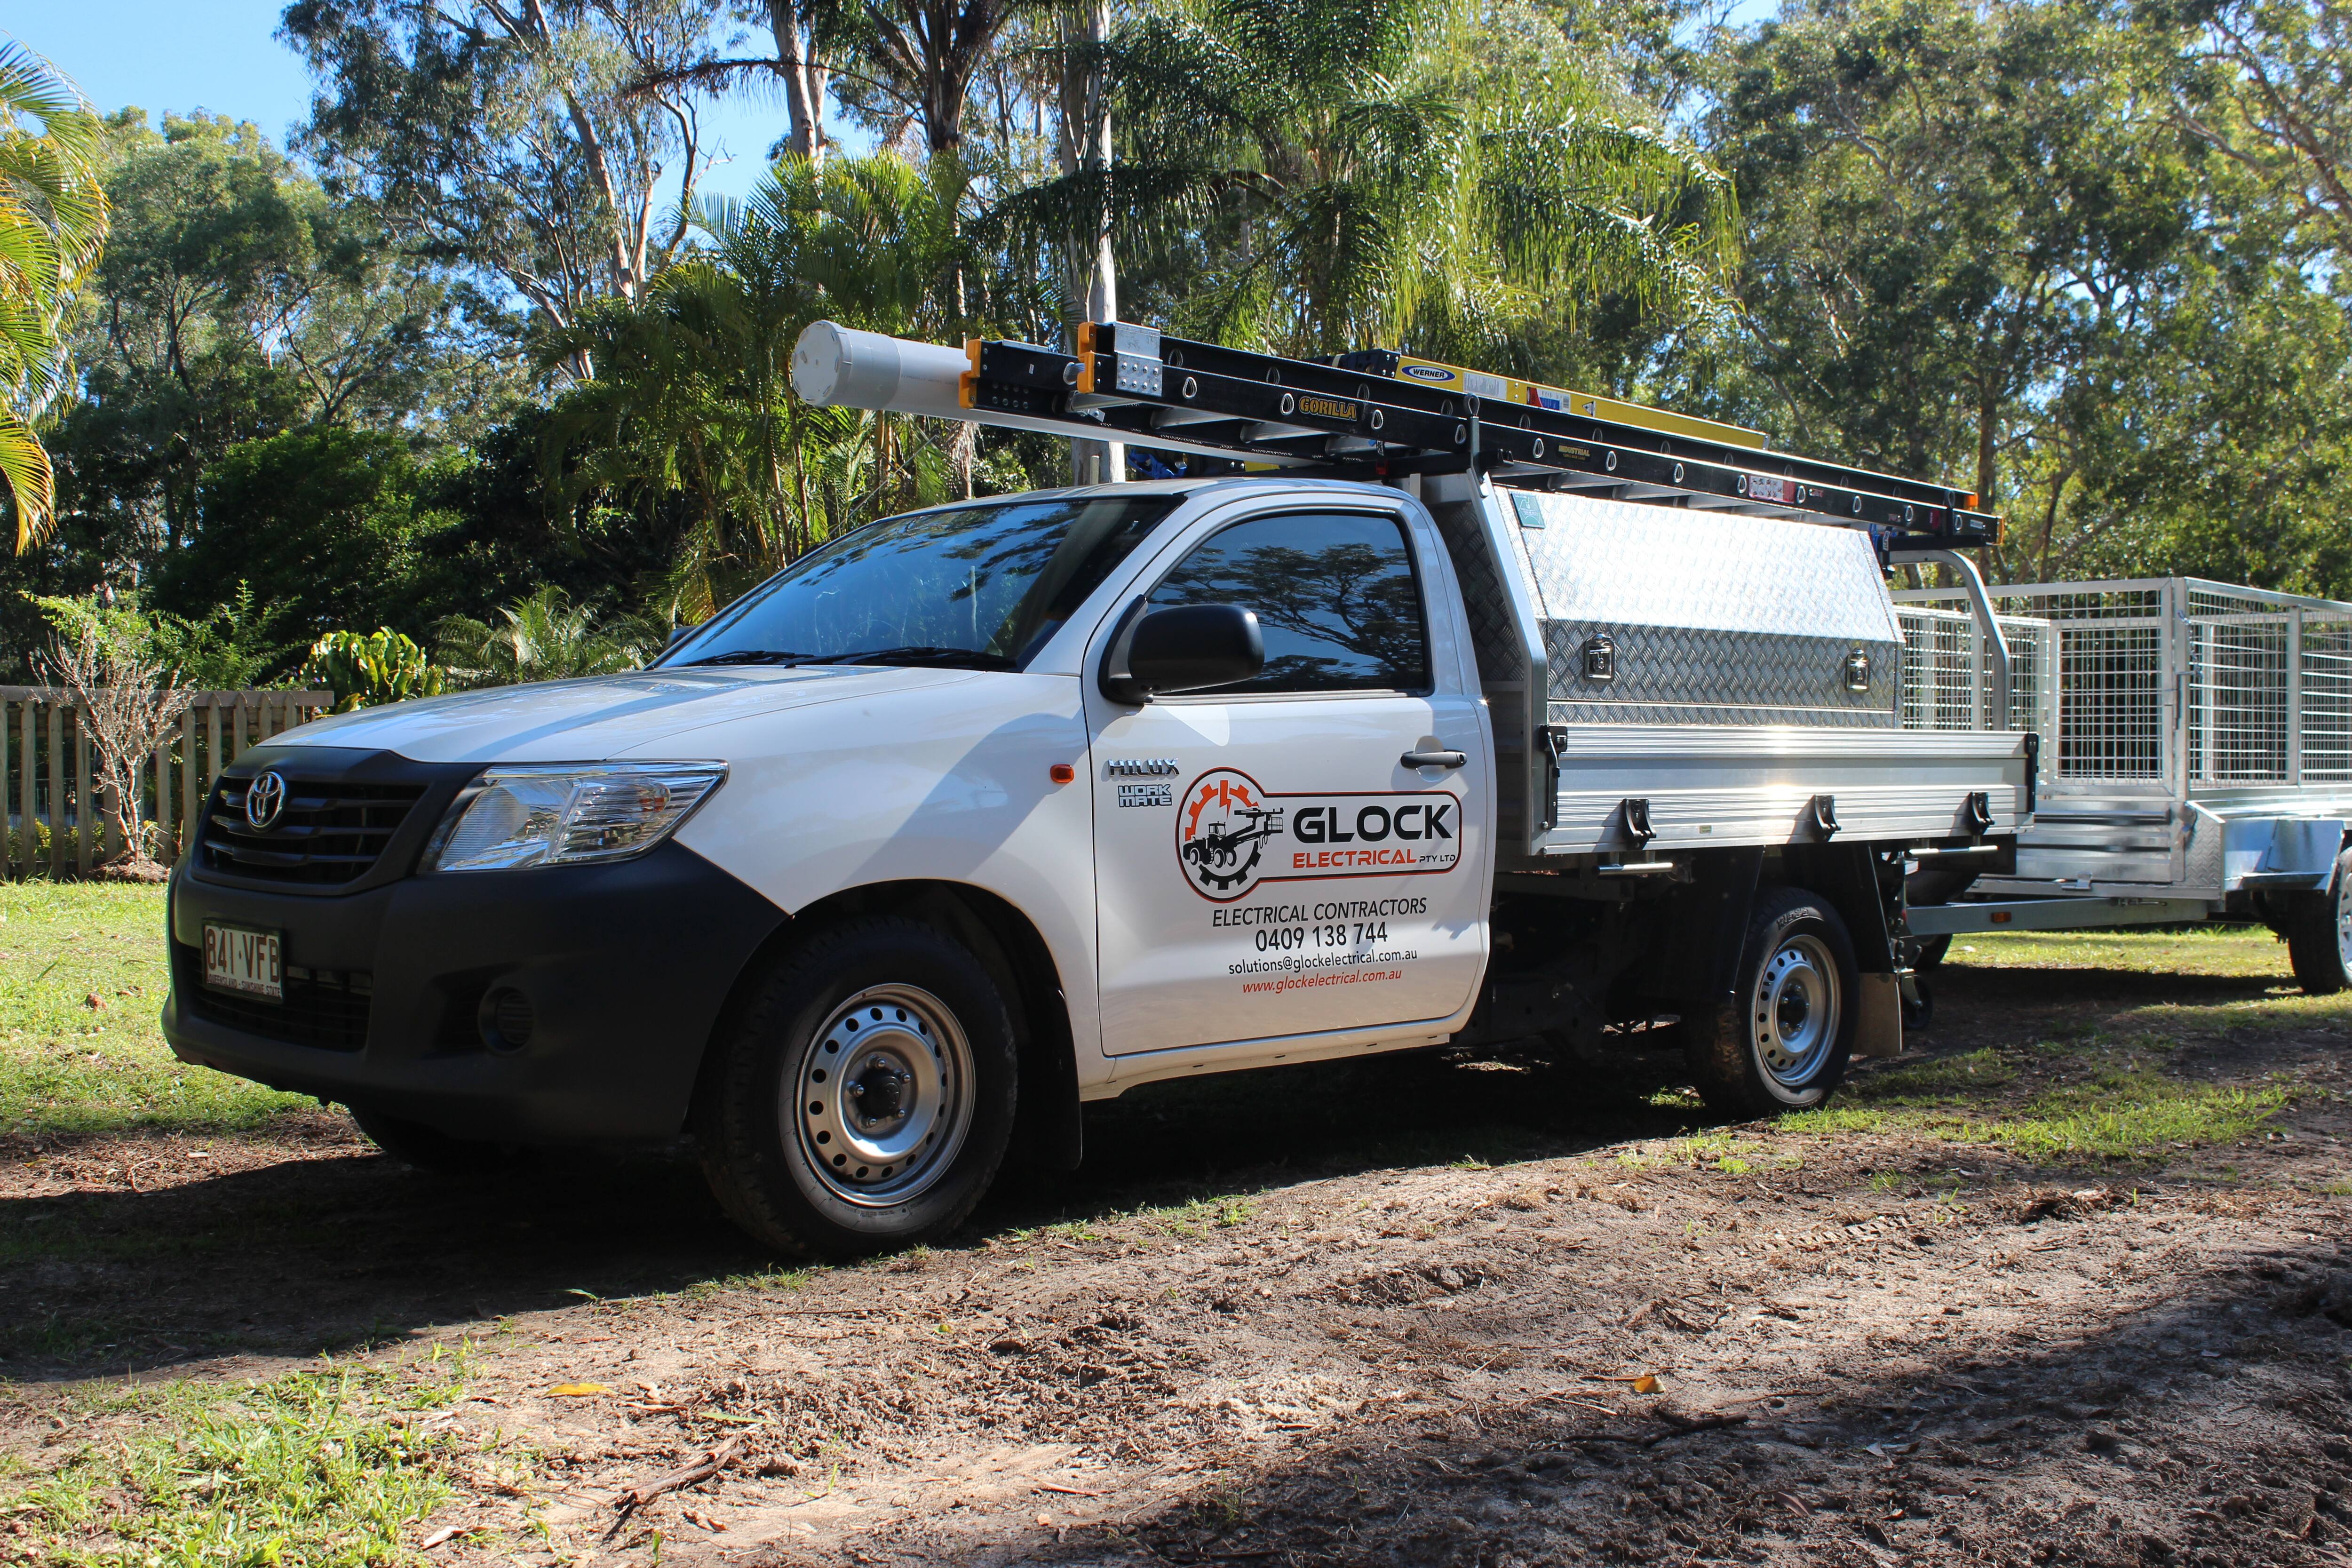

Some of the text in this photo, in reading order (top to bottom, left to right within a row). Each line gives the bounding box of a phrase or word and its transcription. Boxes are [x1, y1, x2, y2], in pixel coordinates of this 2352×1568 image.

[1413, 369, 1445, 378] WERNER
[1299, 397, 1356, 421] GORILLA
[1558, 445, 1590, 457] INDUSTRIAL
[1108, 759, 1179, 777] HILUX
[1118, 784, 1171, 796] WORK
[1119, 795, 1172, 807] MATE
[1293, 804, 1453, 844] GLOCK
[1293, 850, 1417, 868] ELECTRICAL
[1213, 898, 1427, 927] ELECTRICAL CONTRACTORS
[1255, 922, 1388, 952] 0409 138 744
[207, 928, 280, 983] 841 VFB
[1229, 949, 1417, 975] solutions@glockelectrical.com.au
[208, 974, 237, 987] QUEENSLAND
[242, 980, 264, 994] SUNSHINE
[266, 985, 281, 998] STATE
[1243, 970, 1402, 994] www.glockelectrical.com.au
